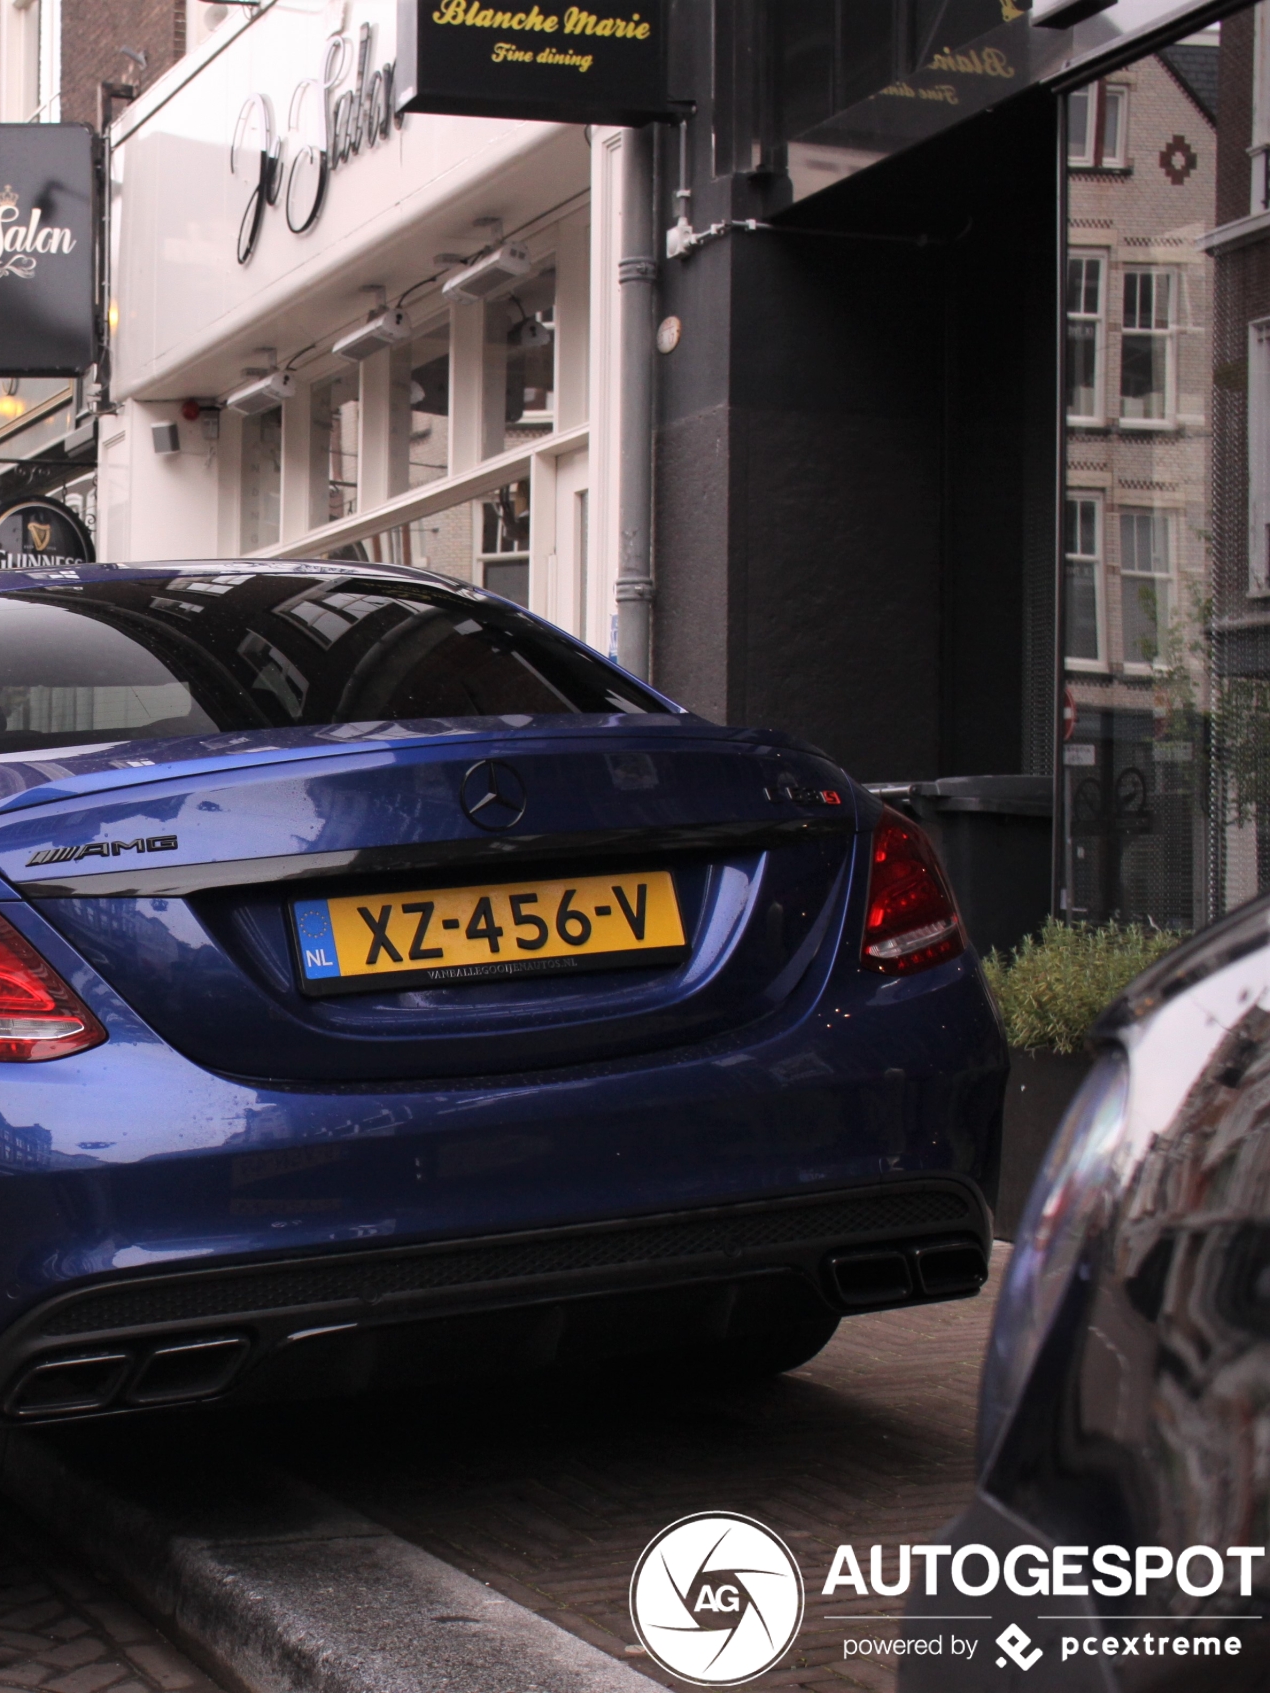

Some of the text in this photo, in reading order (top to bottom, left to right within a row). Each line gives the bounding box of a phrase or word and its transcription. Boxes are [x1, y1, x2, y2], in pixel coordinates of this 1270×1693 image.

[432, 0, 651, 40] Blanche Marie
[491, 42, 593, 73] Fine dining
[357, 883, 648, 965] XZ-456-V
[306, 948, 334, 968] NL
